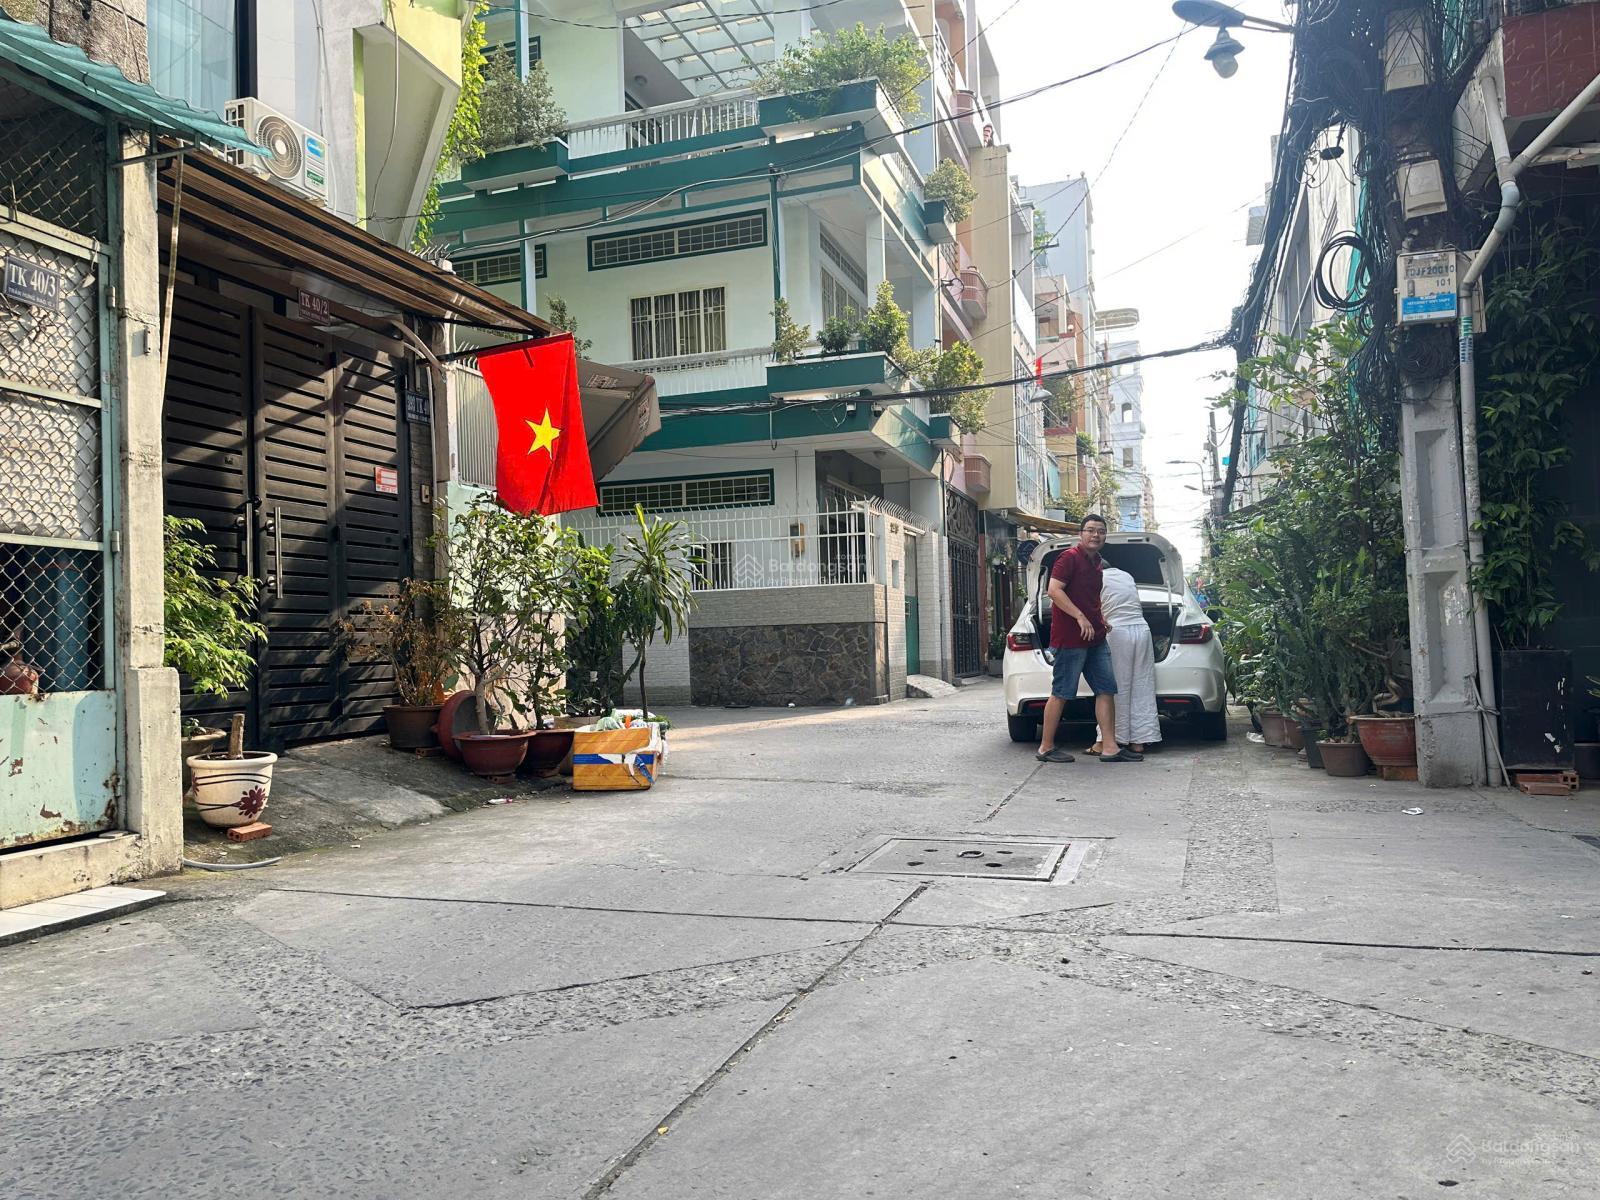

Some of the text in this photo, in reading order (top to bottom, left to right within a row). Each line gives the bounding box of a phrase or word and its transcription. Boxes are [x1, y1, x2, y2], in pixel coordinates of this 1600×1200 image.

[9, 263, 56, 298] TK 40/3
[300, 291, 311, 308] TK
